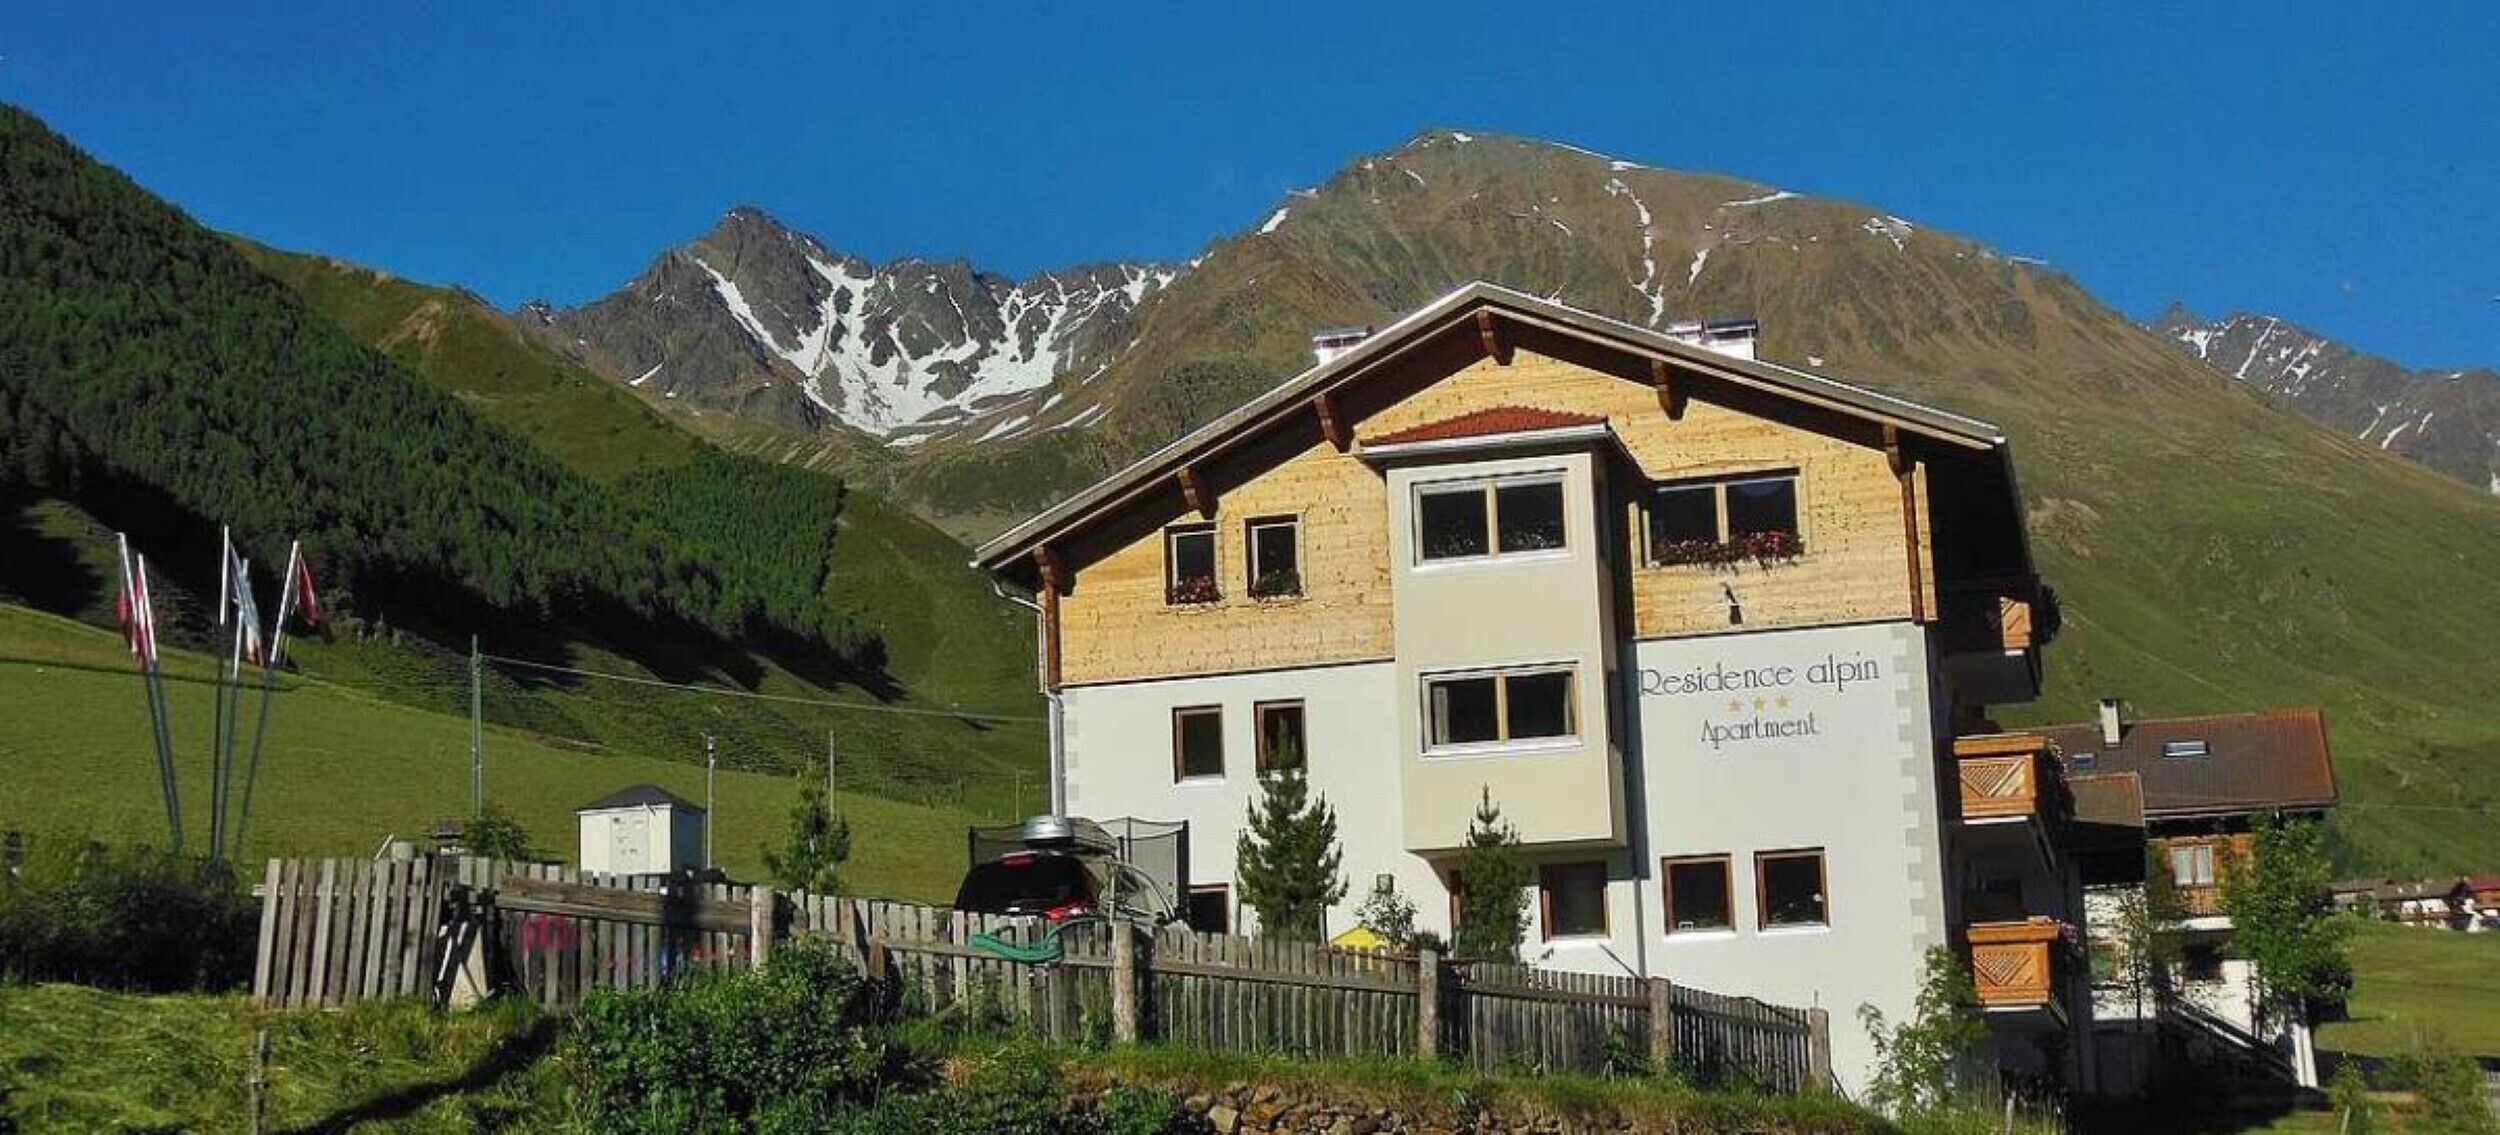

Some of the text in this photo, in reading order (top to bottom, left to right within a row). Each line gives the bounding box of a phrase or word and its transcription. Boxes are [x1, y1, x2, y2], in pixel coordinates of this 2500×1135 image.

[1639, 651, 1880, 696] Residence alpin
[1701, 711, 1820, 749] Apartment
